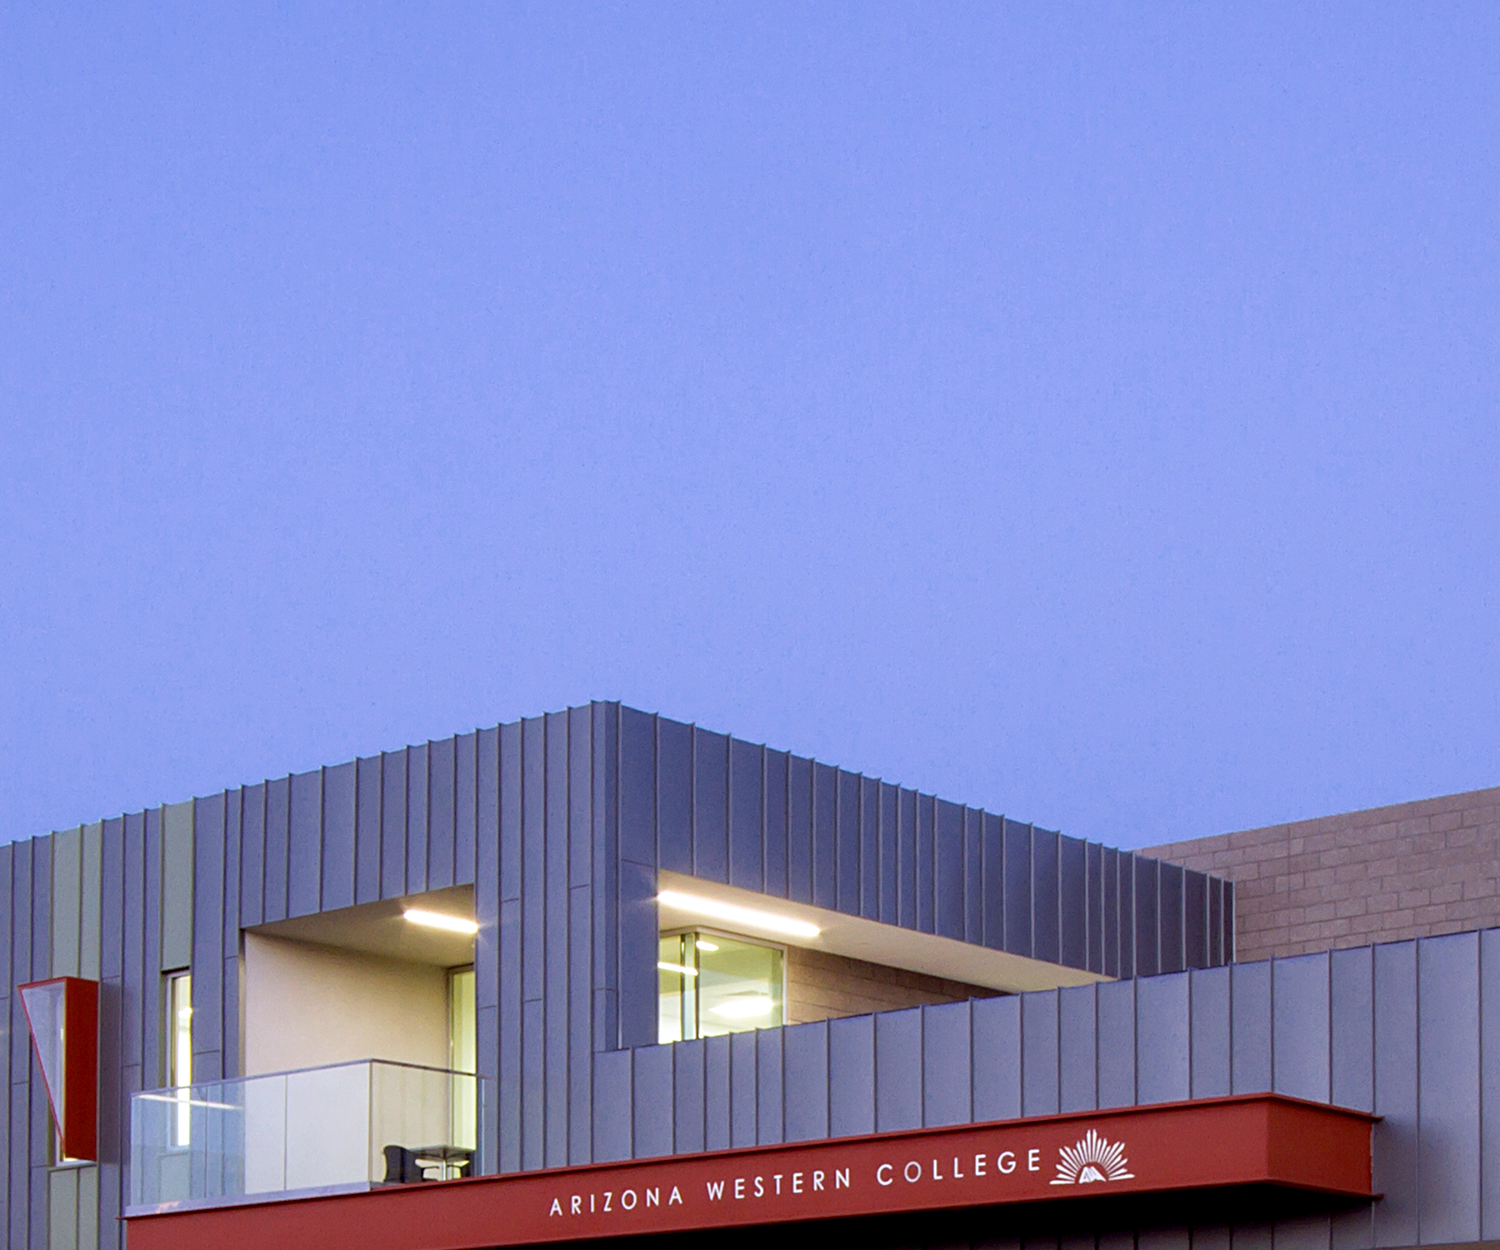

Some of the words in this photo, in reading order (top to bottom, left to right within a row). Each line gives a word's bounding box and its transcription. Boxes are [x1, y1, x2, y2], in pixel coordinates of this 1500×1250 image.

[549, 1186, 683, 1217] ARIZONA
[706, 1168, 850, 1201] WESTERN
[876, 1149, 1040, 1186] COLLEGE
